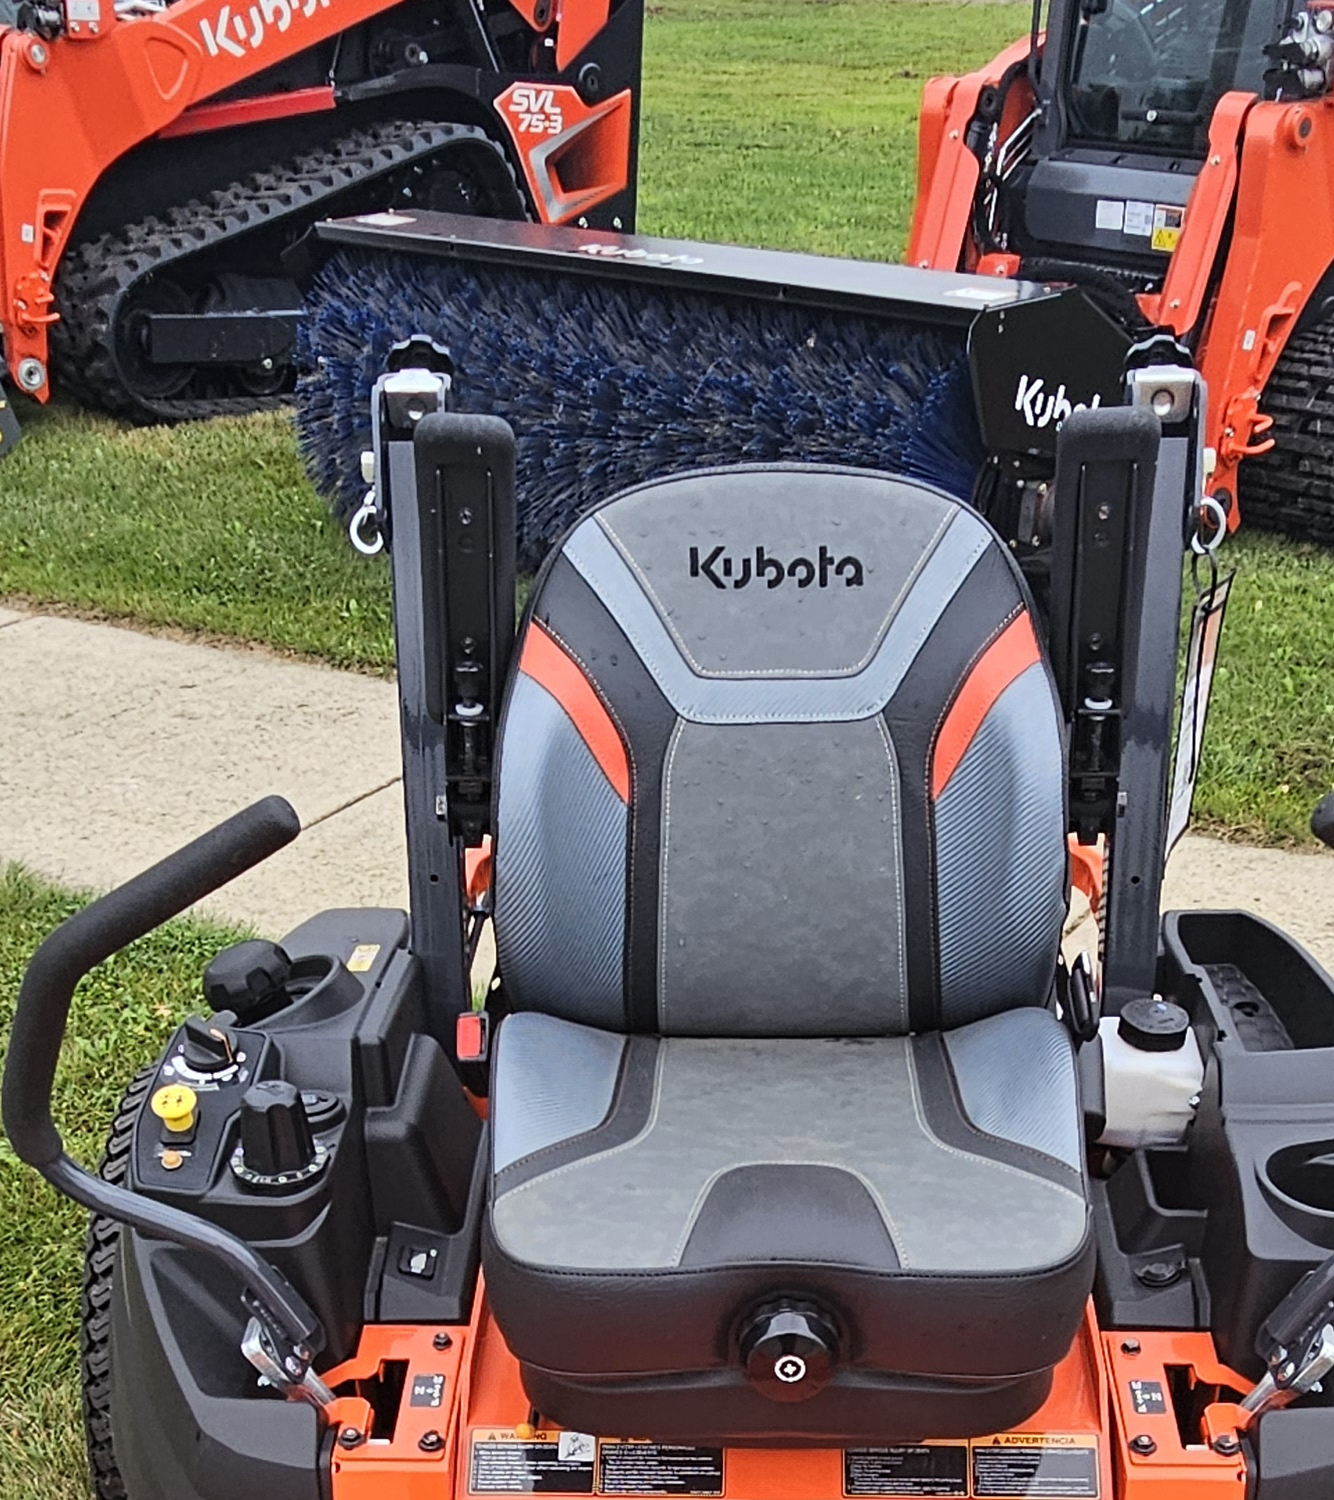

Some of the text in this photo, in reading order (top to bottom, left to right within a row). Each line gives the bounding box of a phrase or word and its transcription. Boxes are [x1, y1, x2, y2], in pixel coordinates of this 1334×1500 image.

[199, 0, 331, 58] Kub
[508, 88, 562, 114] SVL
[1014, 374, 1101, 428] Kub
[689, 545, 865, 590] Kubota
[1004, 1436, 1076, 1445] ADVERTENCIA
